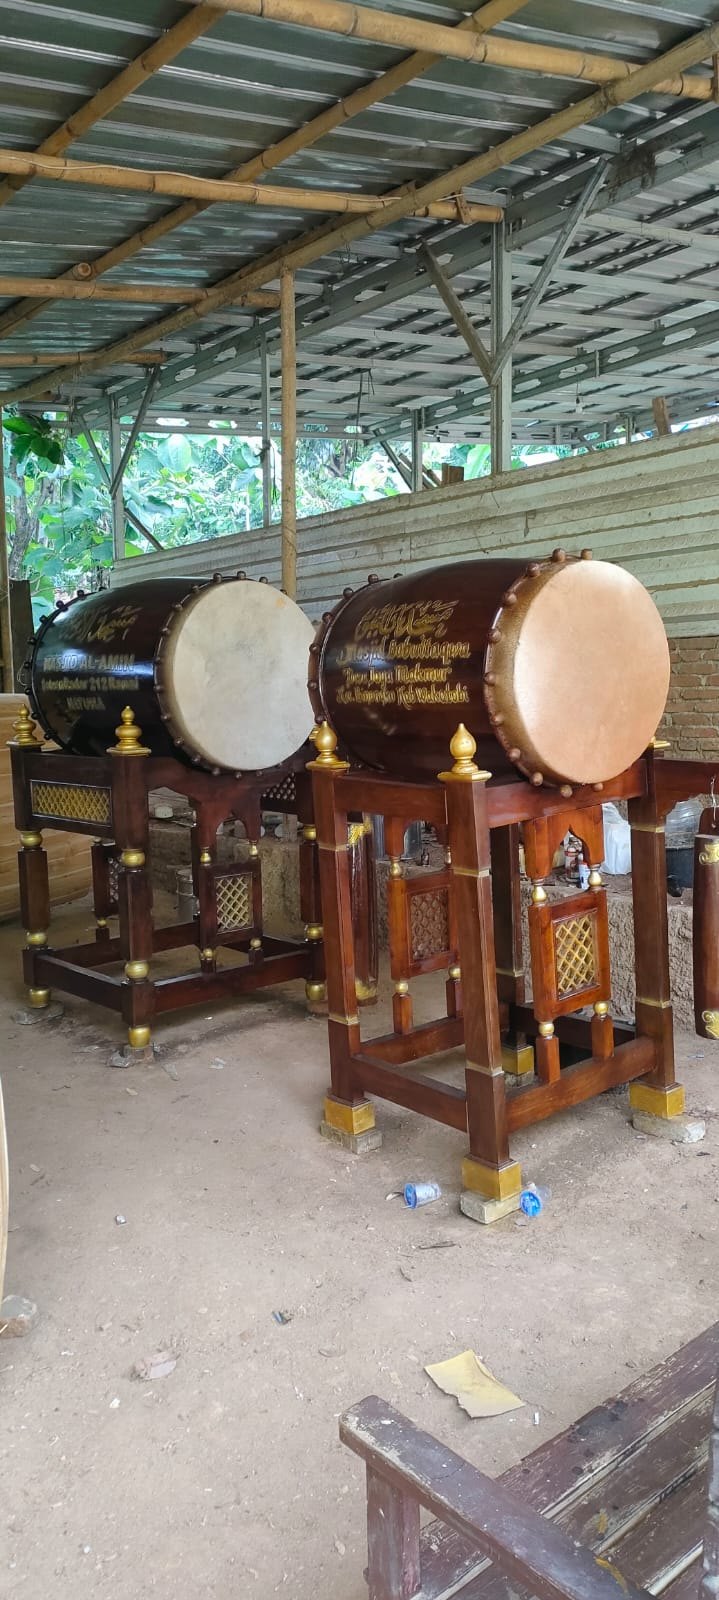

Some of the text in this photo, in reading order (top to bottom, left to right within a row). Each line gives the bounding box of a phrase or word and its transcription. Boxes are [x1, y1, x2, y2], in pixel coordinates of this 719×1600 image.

[336, 635, 387, 666] Masjid
[79, 654, 135, 671] AL-AMIN
[89, 676, 108, 691] 212
